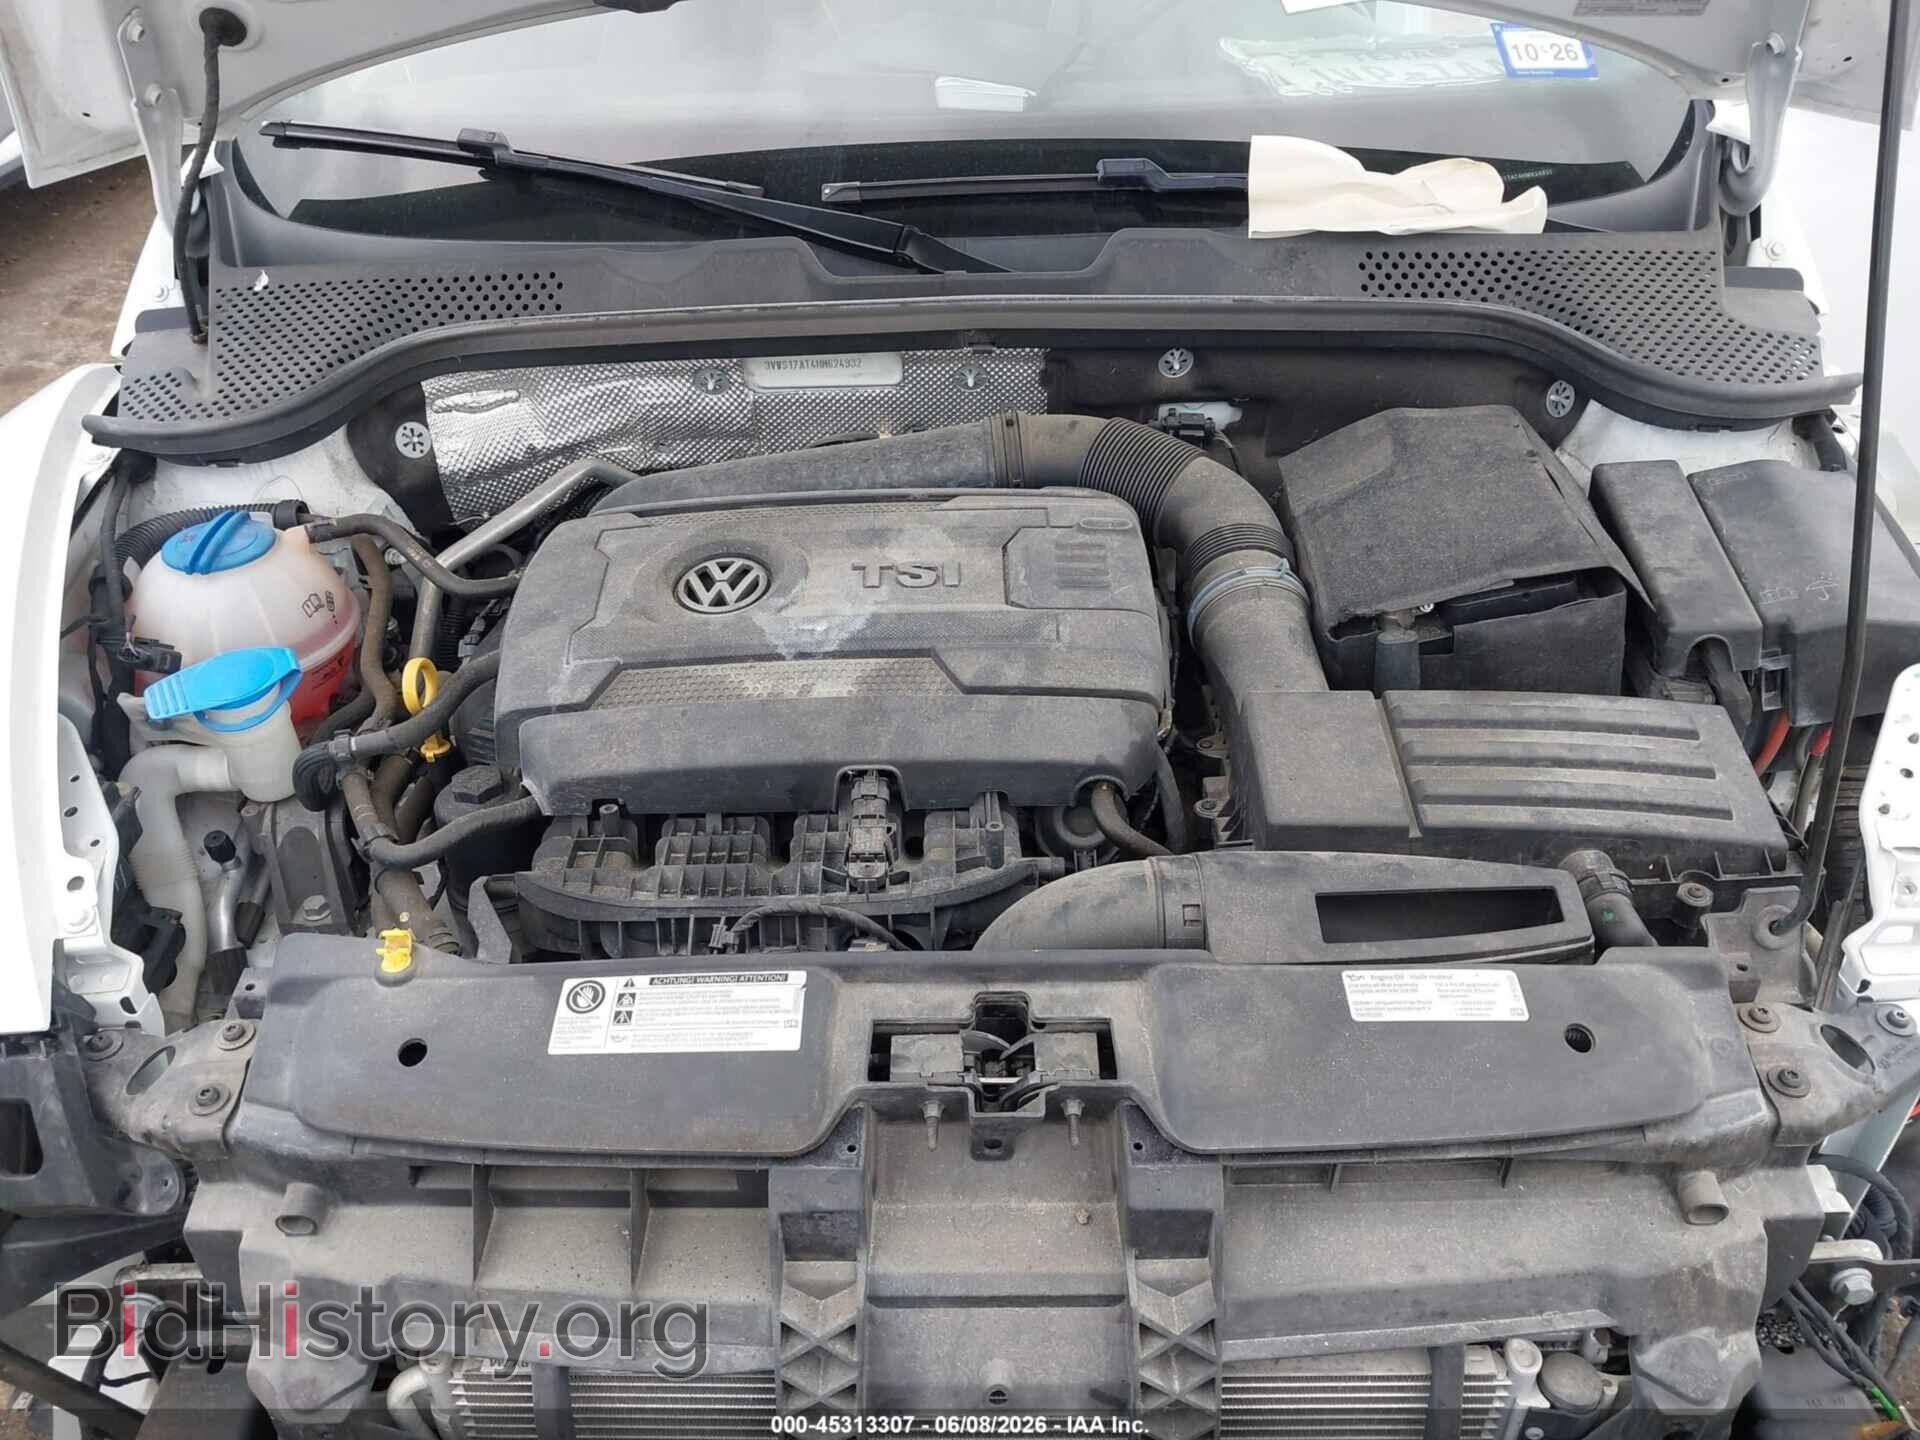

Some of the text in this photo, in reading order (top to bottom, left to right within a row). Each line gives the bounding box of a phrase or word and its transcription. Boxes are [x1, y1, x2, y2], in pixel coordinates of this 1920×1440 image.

[1511, 42, 1579, 62] 10 26
[851, 560, 963, 589] TSI
[652, 973, 787, 985] ACHTUNG! WARNING! ATTENTION!
